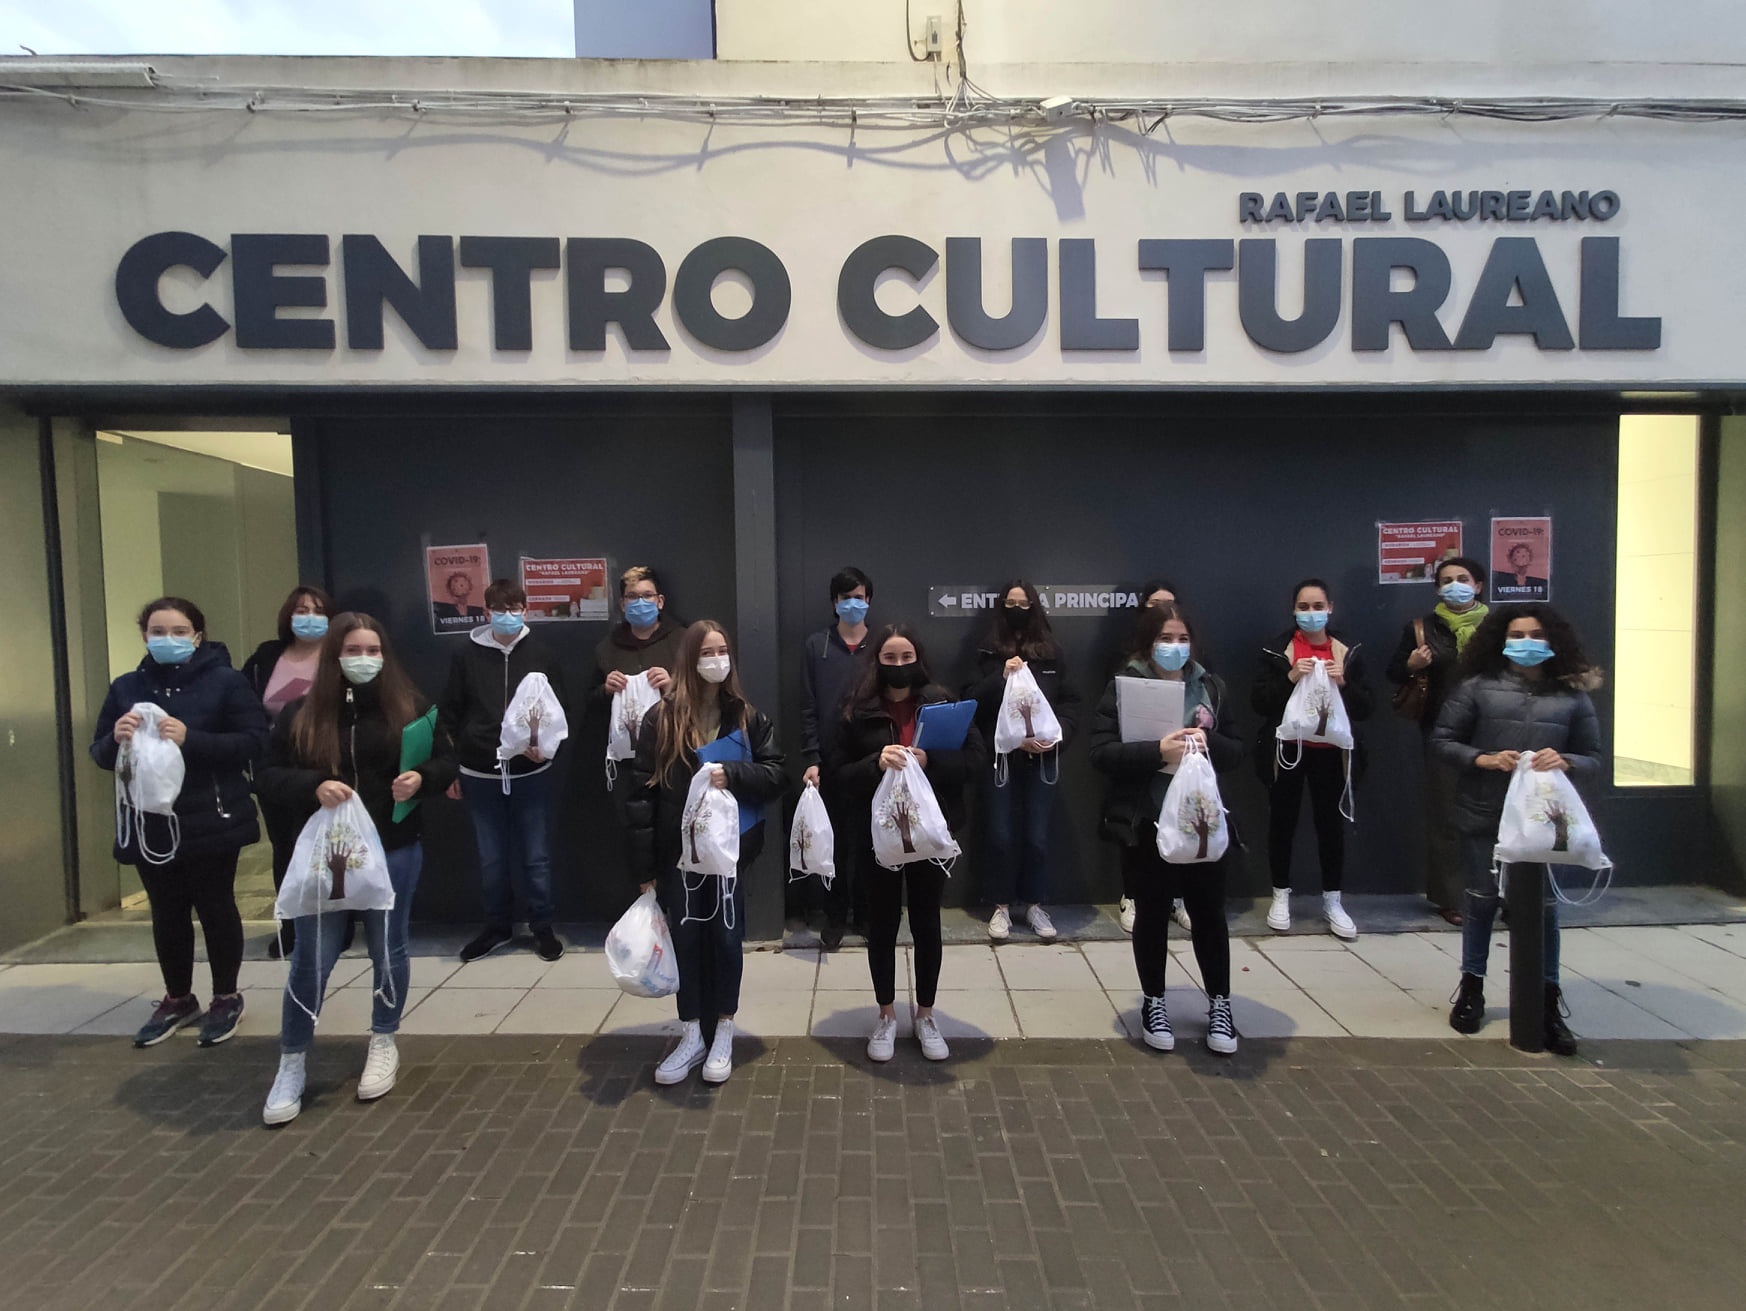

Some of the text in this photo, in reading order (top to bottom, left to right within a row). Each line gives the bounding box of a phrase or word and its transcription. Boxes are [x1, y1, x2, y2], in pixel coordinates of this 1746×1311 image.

[1239, 190, 1622, 224] RAFAEL LAUREANO
[115, 231, 1662, 352] CENTRO CULTURAL
[1383, 526, 1459, 535] CENTRO CULTURAL
[526, 562, 604, 572] CENTRO CULTURAL
[1497, 585, 1532, 594] VIERNES
[961, 592, 1143, 609] ENTA PRINCIPA
[440, 615, 474, 625] VIERNES
